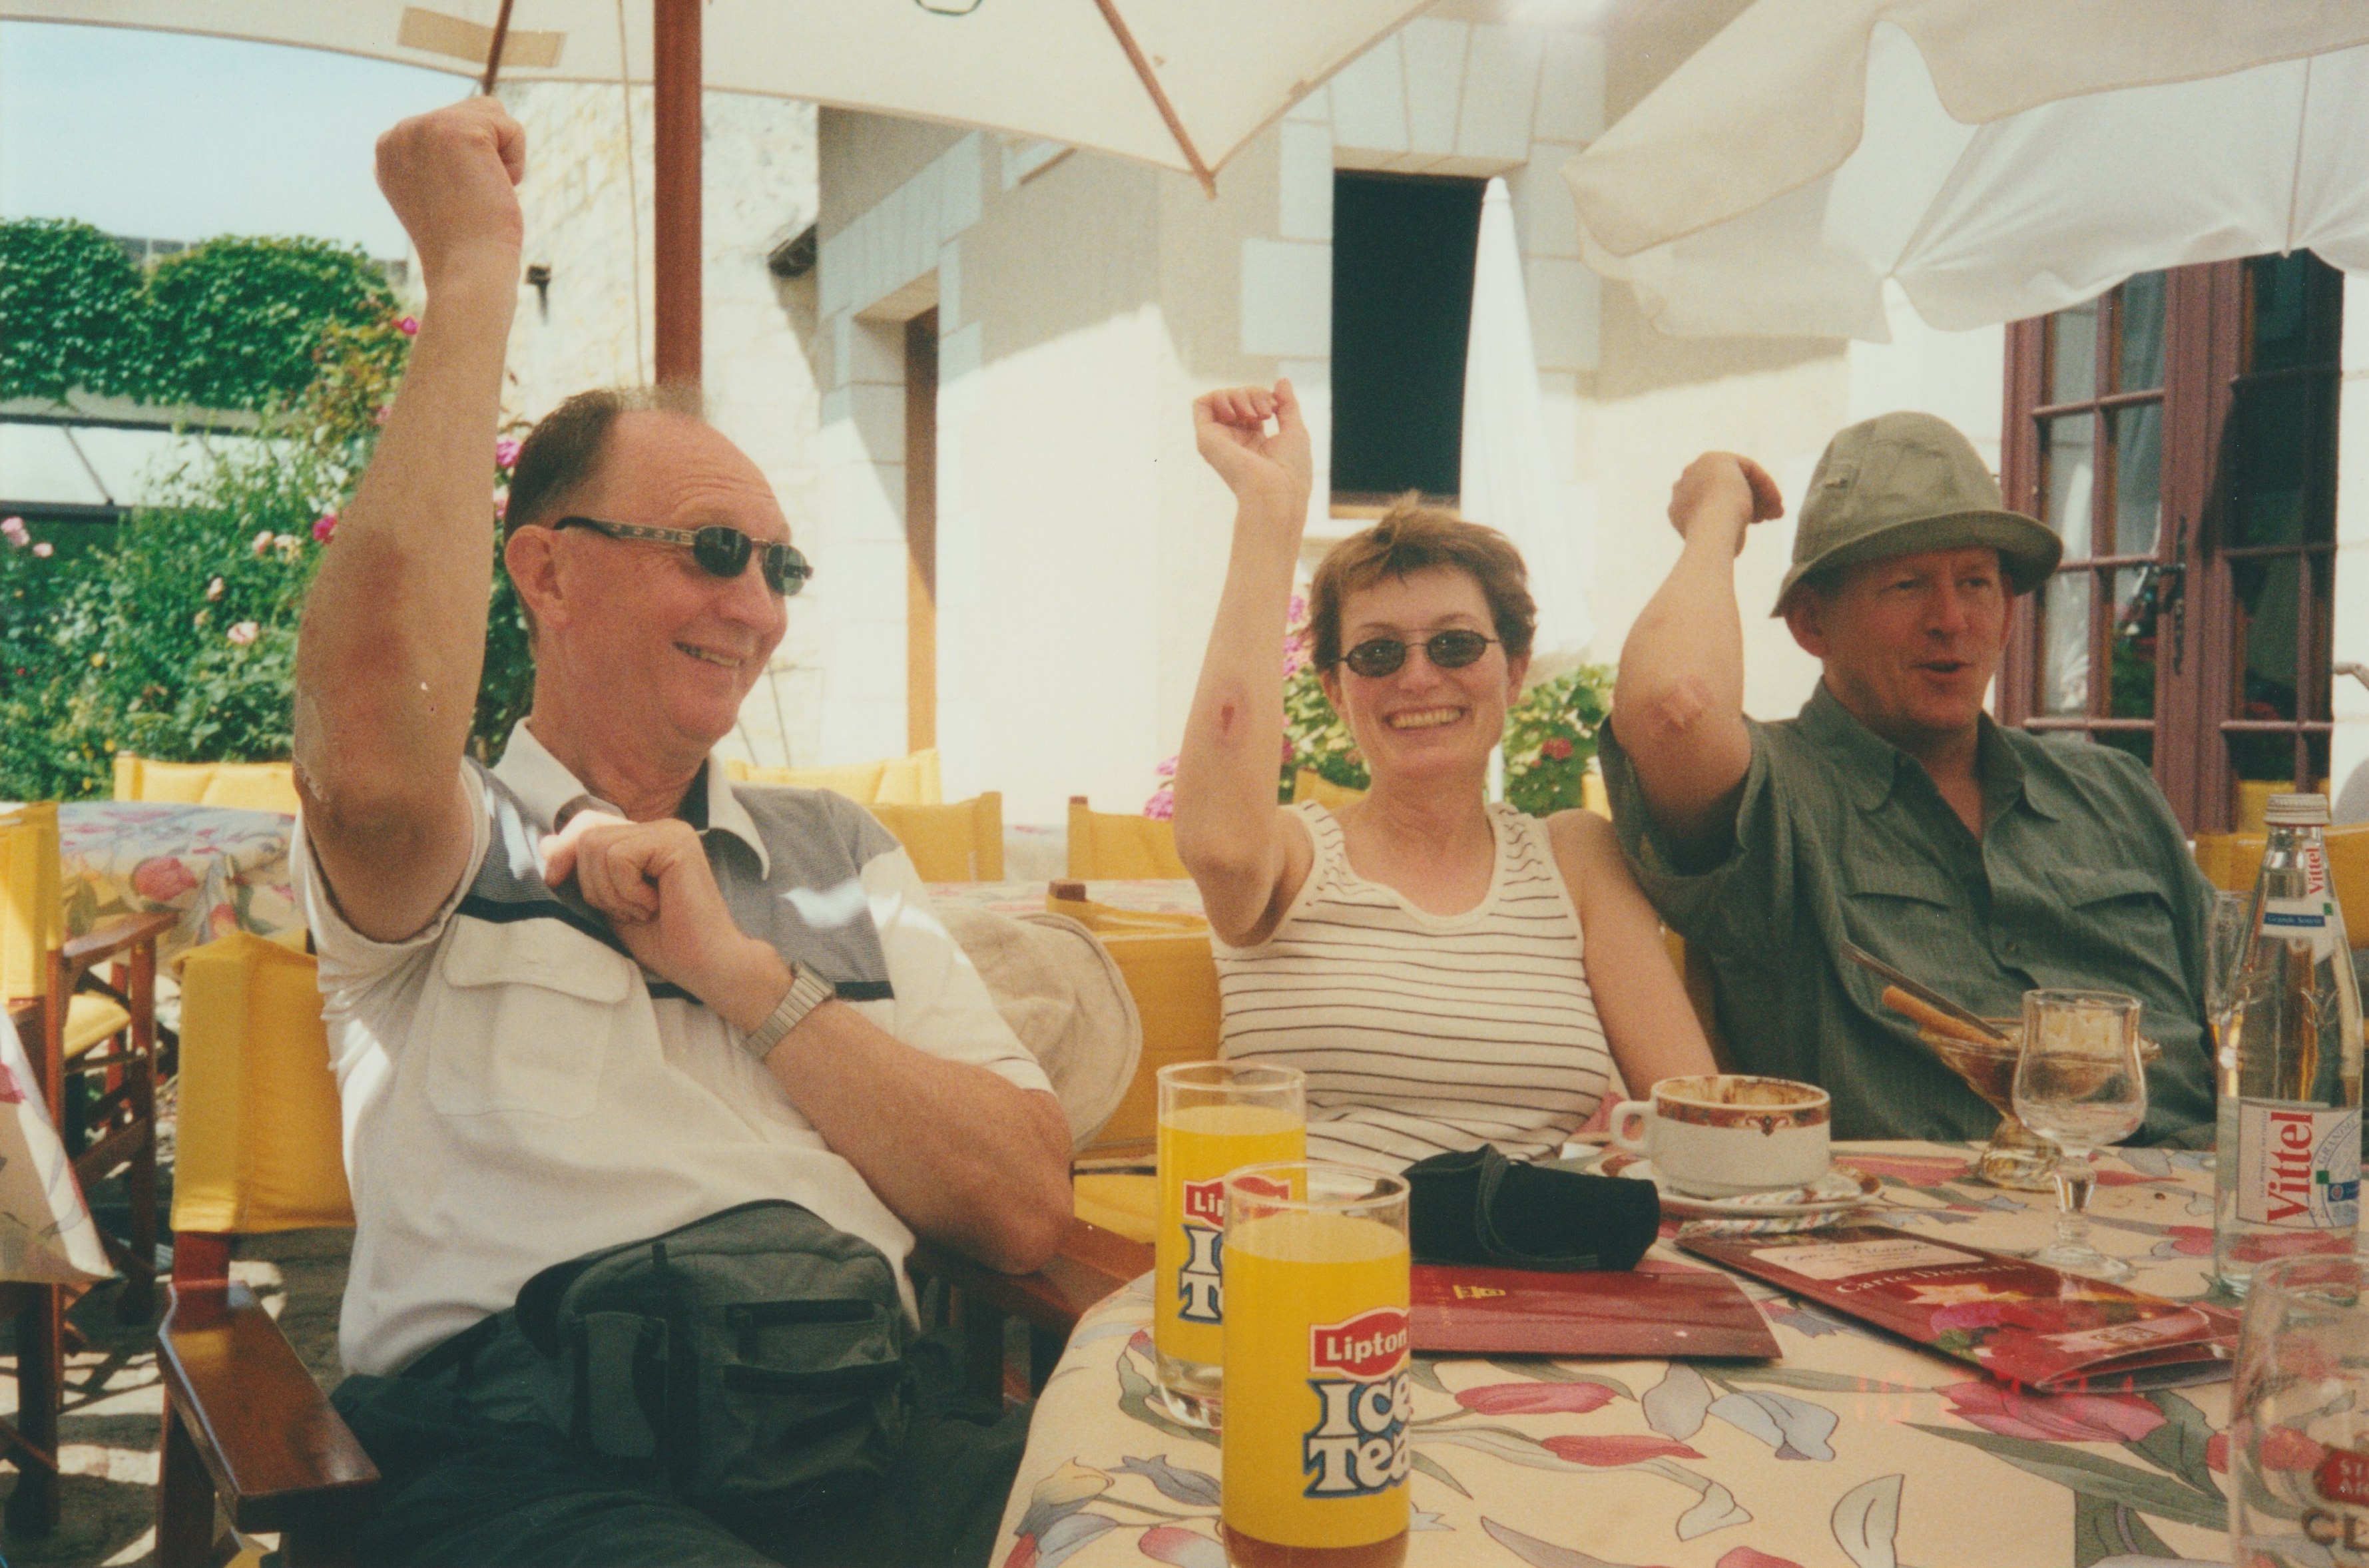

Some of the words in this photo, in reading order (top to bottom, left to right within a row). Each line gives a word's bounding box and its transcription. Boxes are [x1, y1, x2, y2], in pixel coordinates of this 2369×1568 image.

[2305, 848, 2324, 894] Vittel
[2267, 1111, 2314, 1221] Vittel
[1836, 1272, 1911, 1294] Carte
[1326, 1328, 1408, 1364] Lipton
[1310, 1372, 1410, 1436] Ice
[1305, 1430, 1410, 1493] Tea
